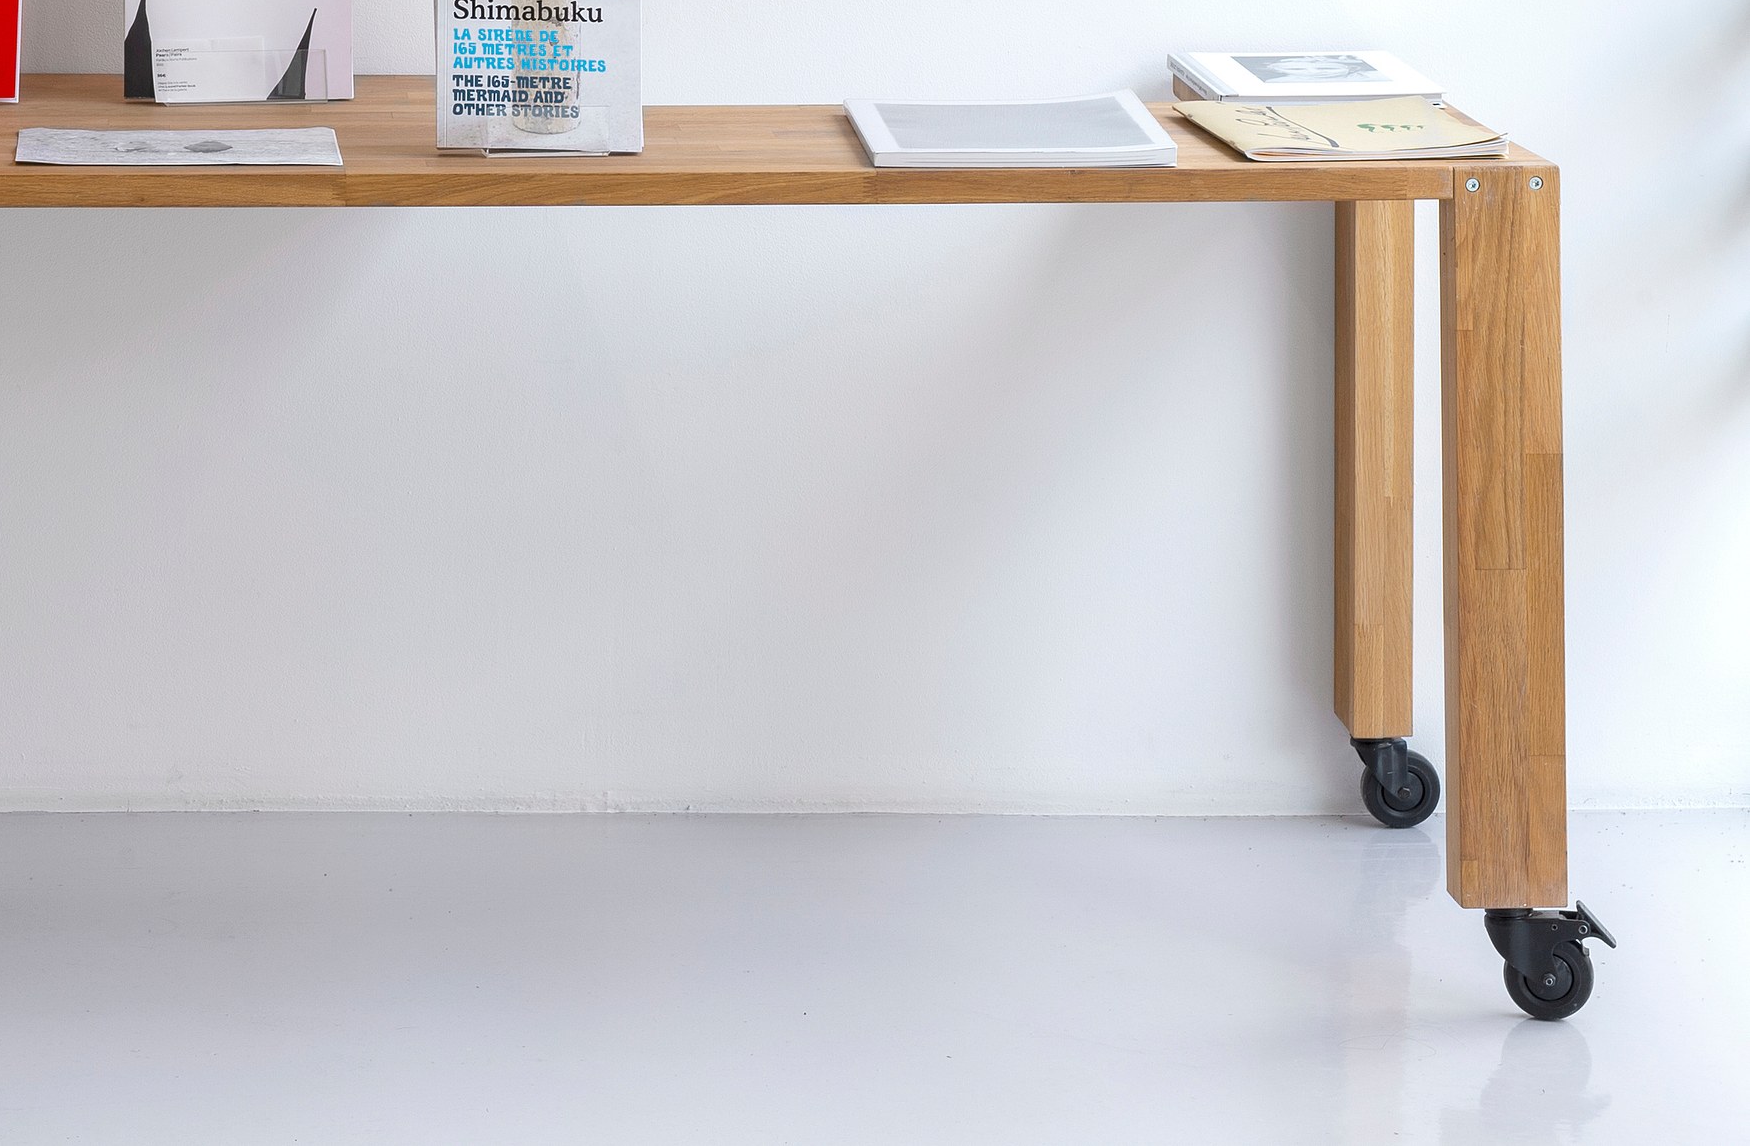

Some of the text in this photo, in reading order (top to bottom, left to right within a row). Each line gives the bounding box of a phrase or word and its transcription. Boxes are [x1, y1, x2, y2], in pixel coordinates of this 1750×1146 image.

[453, 26, 559, 42] LA SIRÈNE DE
[453, 42, 476, 54] 165
[553, 45, 574, 57] ET
[453, 56, 606, 72] AUTRES HISTOIRES
[452, 74, 572, 90] THE 165-METRE
[452, 89, 565, 104] MERMAID AND
[452, 103, 580, 119] OTHER STORIES
